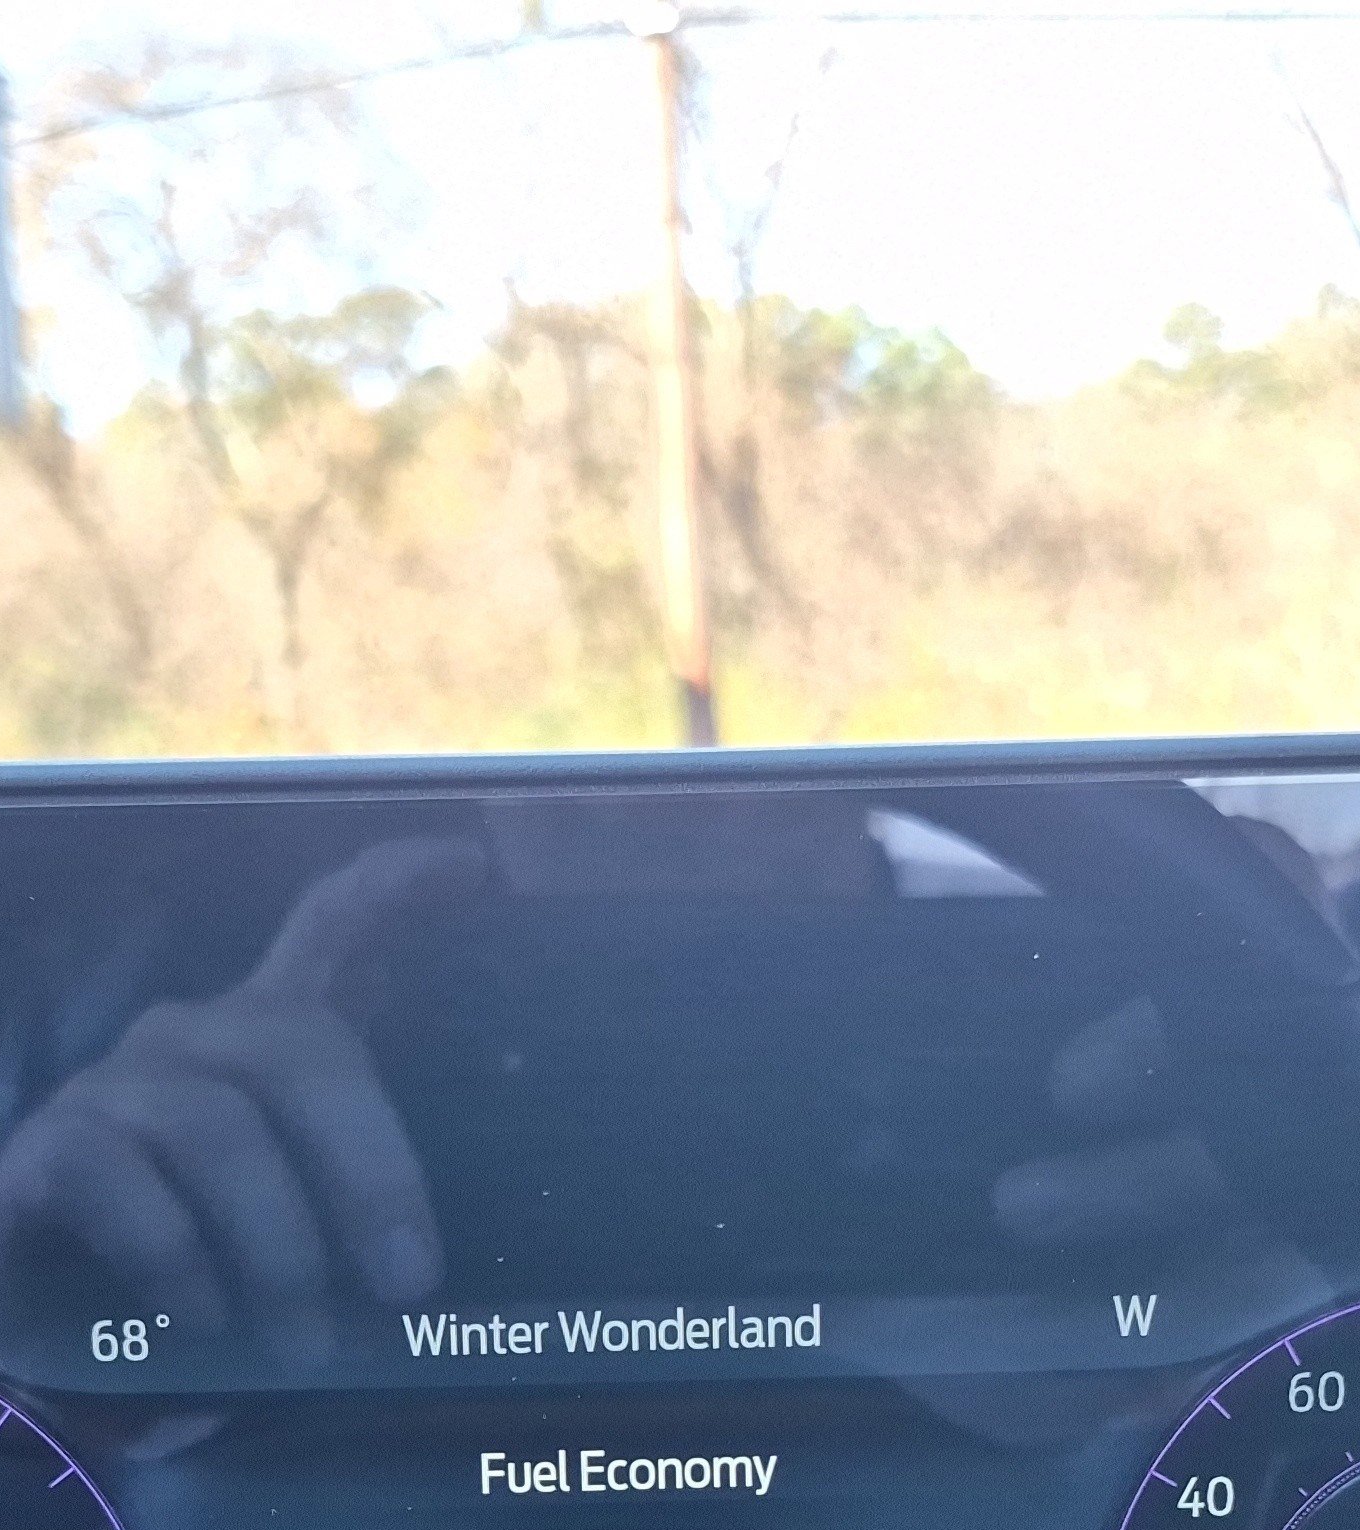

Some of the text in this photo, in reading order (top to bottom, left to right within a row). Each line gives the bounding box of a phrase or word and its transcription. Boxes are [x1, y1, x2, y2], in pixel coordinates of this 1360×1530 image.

[402, 1303, 821, 1357] Winter Wonderland
[1113, 1294, 1157, 1337] W
[1288, 1370, 1346, 1413] 60
[480, 1449, 778, 1496] Fuel Economy
[1177, 1475, 1235, 1518] 40
